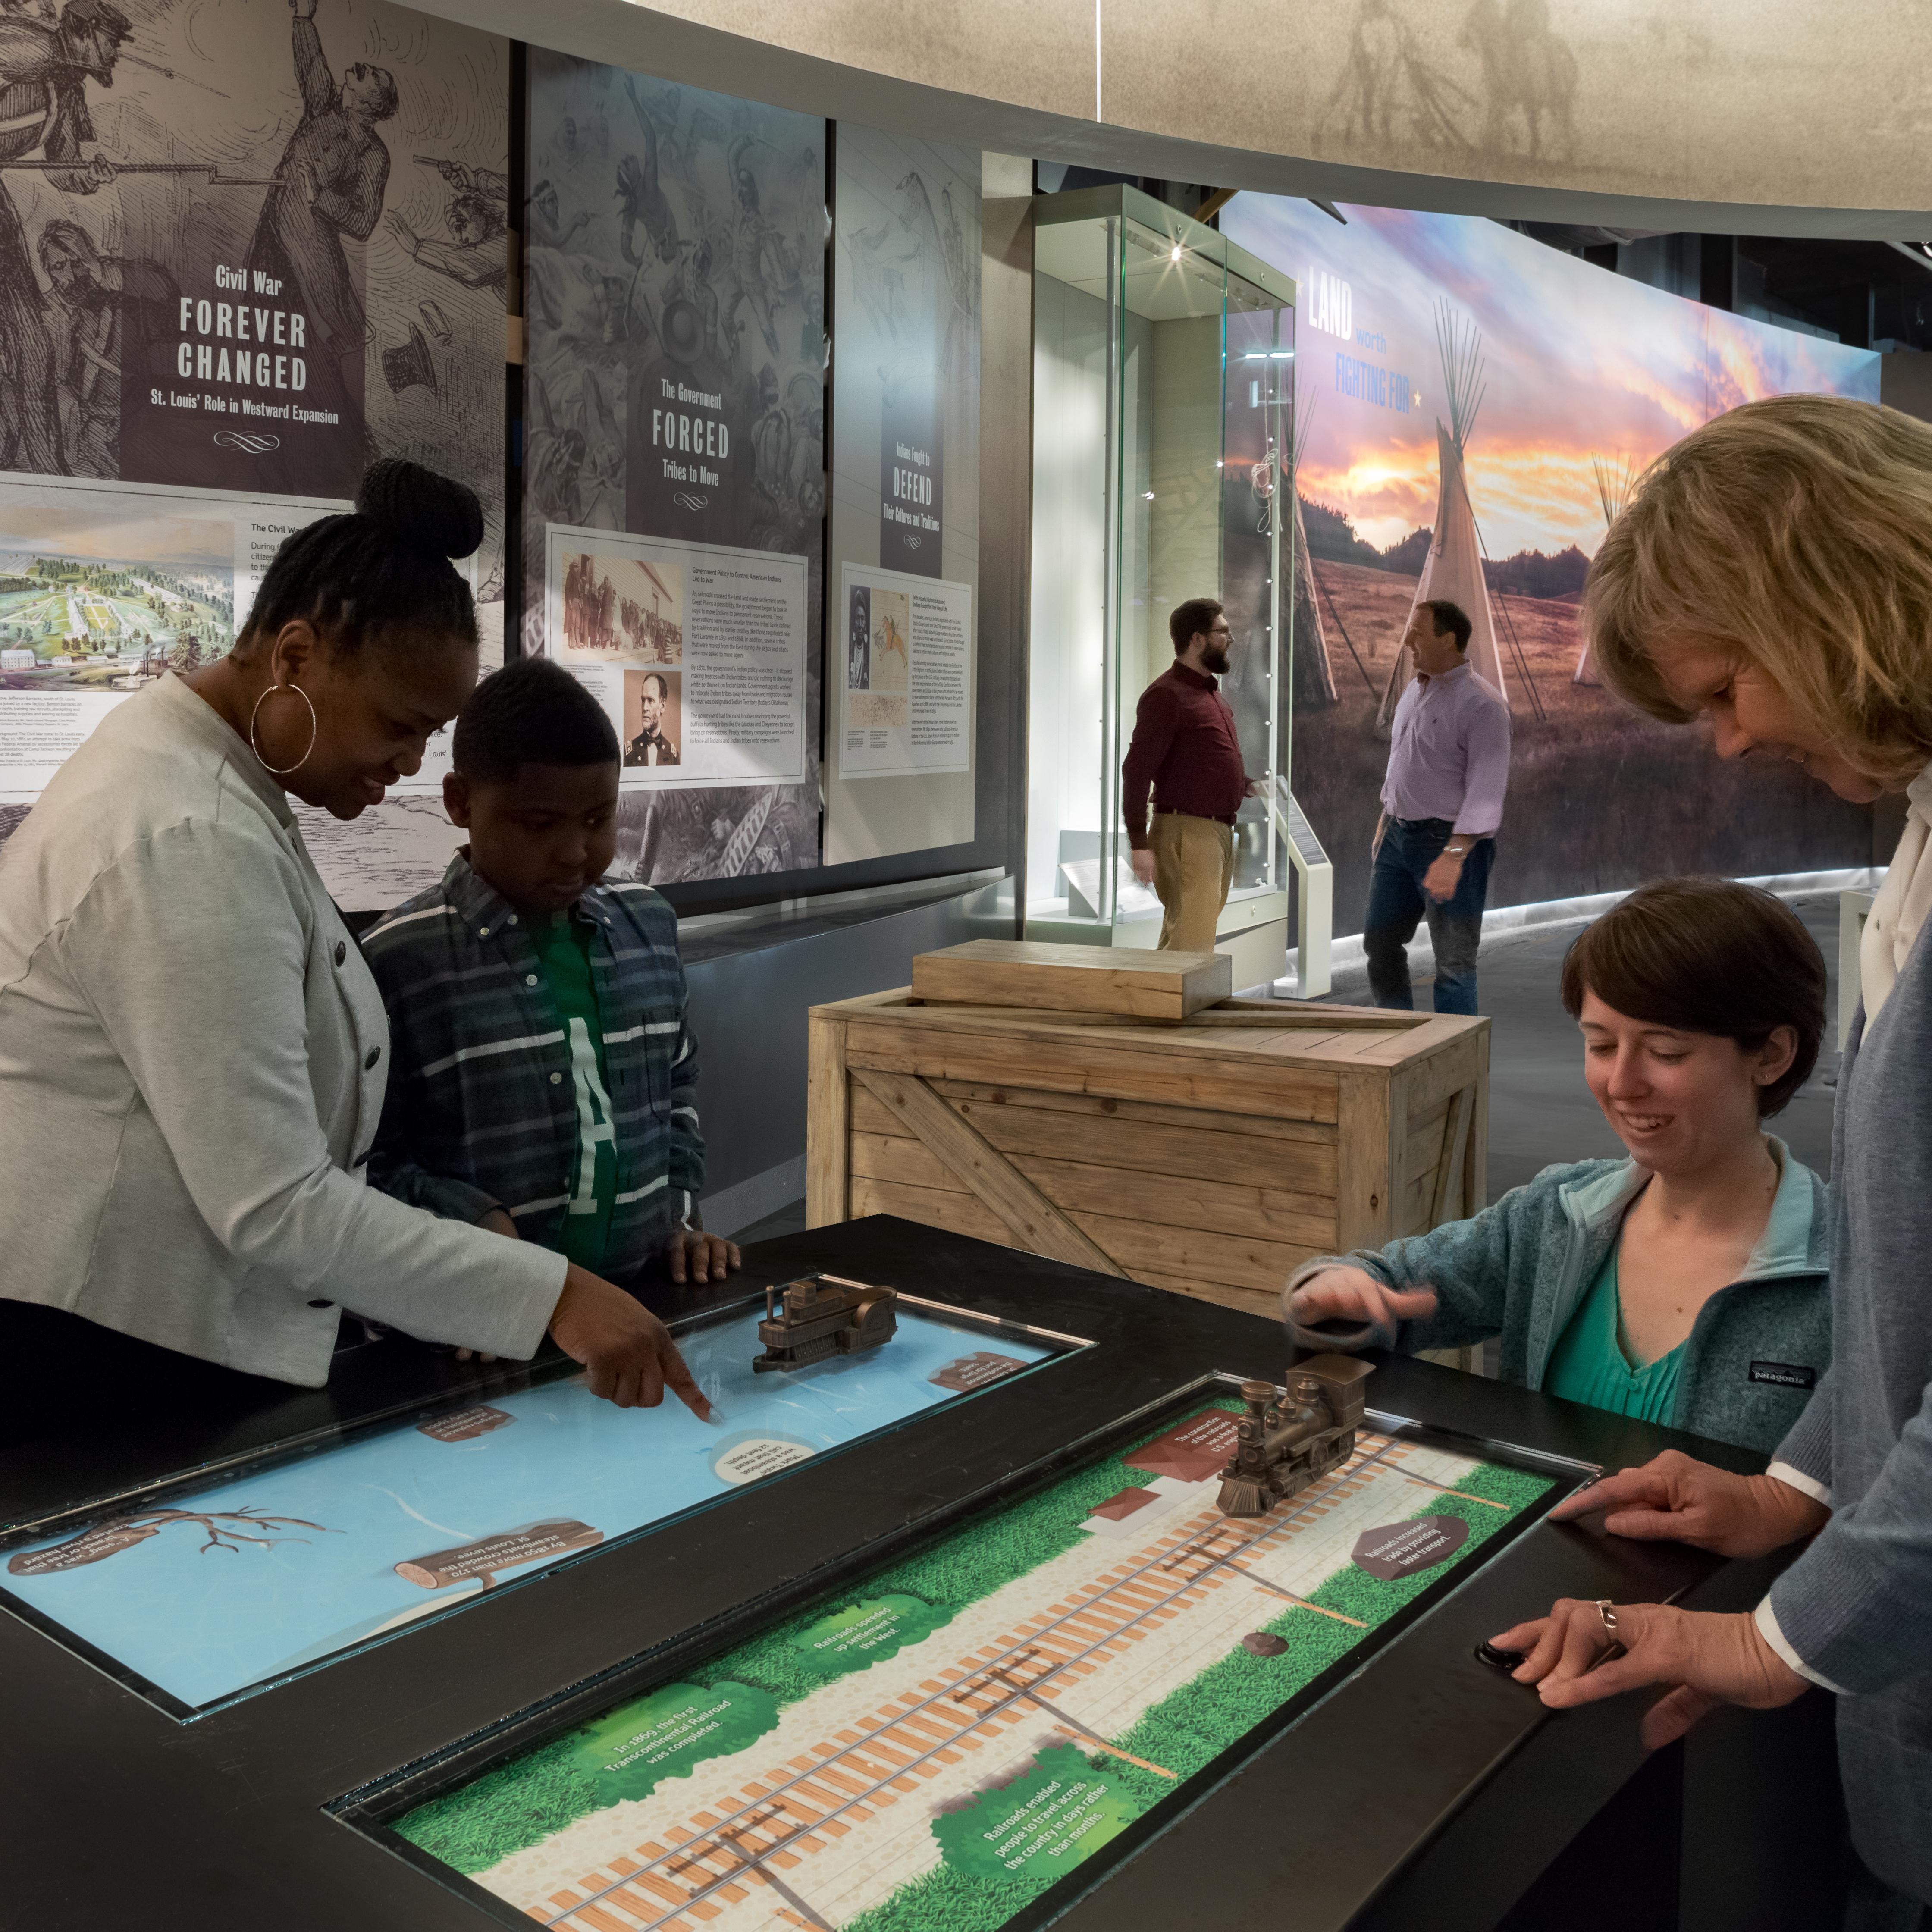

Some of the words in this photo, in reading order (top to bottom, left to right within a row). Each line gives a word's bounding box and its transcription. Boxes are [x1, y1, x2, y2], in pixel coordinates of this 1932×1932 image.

[216, 265, 246, 290] Civil
[254, 270, 281, 295] War
[1309, 266, 1352, 341] LAND
[180, 297, 305, 348] FOREVER
[1355, 328, 1386, 354] worth
[178, 342, 307, 391] CHANGED
[661, 378, 674, 398] The
[678, 383, 721, 409] Government
[1336, 352, 1386, 407] FIGHTING
[1389, 372, 1409, 414] FOR
[151, 389, 166, 405] St.
[204, 395, 225, 411] Role
[229, 398, 238, 413] in
[242, 399, 288, 418] Westward
[293, 405, 338, 423] Expansion
[653, 409, 728, 458] FORCED
[897, 441, 910, 460] Indians
[912, 447, 924, 466] Fought
[925, 452, 929, 466] to
[663, 459, 686, 480] Tribes
[689, 465, 696, 482] to
[700, 466, 718, 486] Move
[894, 467, 932, 506] DEFEND
[251, 523, 266, 532] The
[268, 524, 286, 533] Civil
[884, 503, 894, 520] Their
[895, 506, 911, 524] Cultures
[921, 513, 939, 531] Traditions
[251, 542, 275, 552] During
[692, 567, 716, 575] Government
[717, 569, 729, 578] Policy
[1755, 1371, 1805, 1384] patagonia
[1188, 1417, 1221, 1435] construction
[1206, 1421, 1231, 1435] railroads
[724, 1454, 746, 1464] depth.
[732, 1459, 755, 1470] meant
[740, 1457, 777, 1474] steamboat
[485, 1540, 514, 1550] Louis
[502, 1535, 559, 1553] steamboats
[524, 1546, 549, 1556] 1850
[1365, 1540, 1399, 1557] Railroads
[1394, 1522, 1427, 1540] increased
[1381, 1550, 1403, 1561] trade
[1408, 1529, 1440, 1547] providing
[1398, 1552, 1421, 1565] faster
[1416, 1536, 1450, 1554] transport.
[454, 1549, 486, 1558] levee.
[458, 1552, 501, 1567] crowded
[471, 1562, 497, 1570] than
[497, 1553, 523, 1563] more
[451, 1568, 470, 1577] 170
[814, 1626, 857, 1648] Railroads
[856, 1607, 891, 1627] speeded
[846, 1620, 891, 1644] settlement
[859, 1640, 877, 1649] the
[872, 1628, 900, 1640] West.
[605, 1723, 691, 1770] Transcontinental
[688, 1700, 731, 1725] Railroad
[629, 1730, 660, 1745] 1869,
[656, 1719, 676, 1729] the
[673, 1706, 697, 1719] first
[646, 1751, 669, 1763] was
[668, 1721, 722, 1751] completed.
[983, 1808, 1029, 1840] Railroads
[1026, 1781, 1060, 1808] enabled
[995, 1831, 1027, 1857] people
[1021, 1823, 1037, 1832] to
[1031, 1802, 1061, 1823] travel
[1057, 1782, 1086, 1804] across
[1004, 1856, 1025, 1869] the
[1022, 1828, 1058, 1856] country
[1051, 1821, 1066, 1829] in
[1062, 1805, 1085, 1822] days
[1082, 1784, 1107, 1806] rather
[1047, 1839, 1073, 1856] than
[1069, 1813, 1104, 1839] months.
